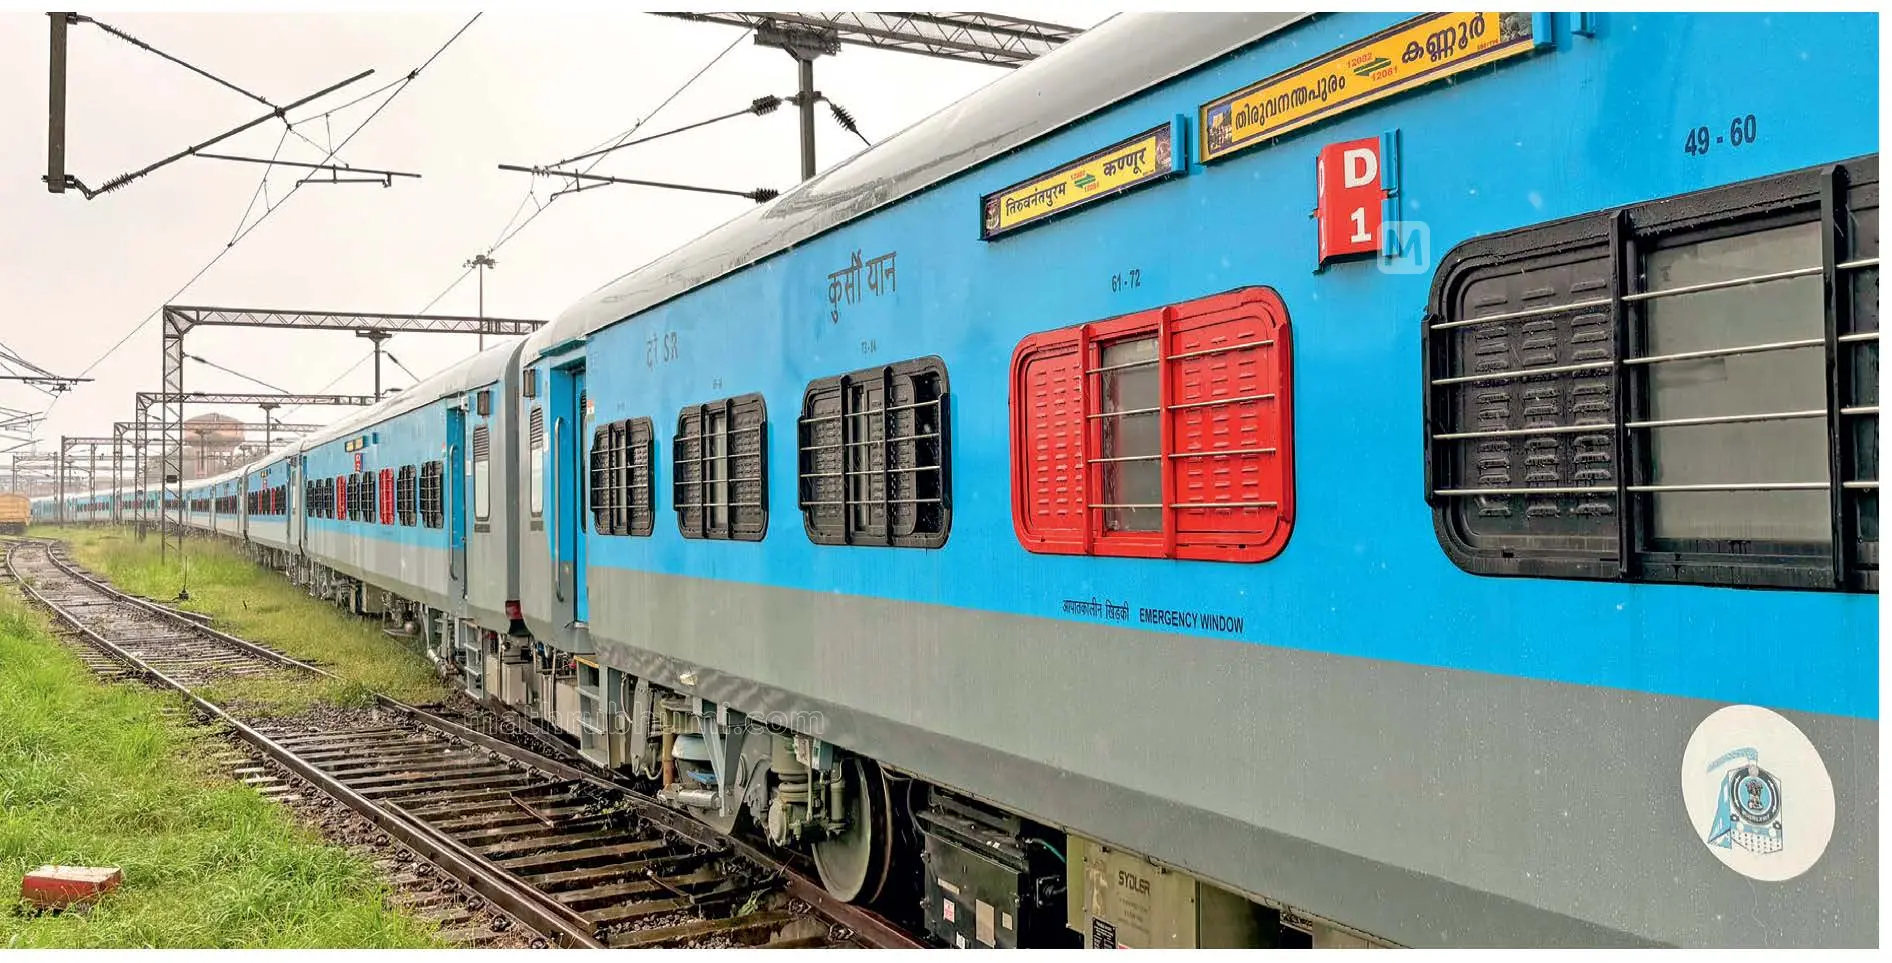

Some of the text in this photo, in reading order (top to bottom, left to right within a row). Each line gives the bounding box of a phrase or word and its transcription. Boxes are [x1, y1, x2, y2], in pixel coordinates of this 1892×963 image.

[1372, 65, 1398, 81] 12081
[1235, 74, 1345, 130] തിരുവനന്തപുരം
[1684, 127, 1710, 156] 49
[1730, 114, 1757, 146] 60
[1343, 148, 1378, 189] D
[1005, 182, 1067, 217] तिरुवनंतपुरम
[1350, 206, 1372, 243] 1
[865, 250, 897, 297] यान
[1111, 272, 1122, 293] 61
[1129, 268, 1141, 290] 72
[1139, 607, 1244, 633] EMERGENCY WINDOW
